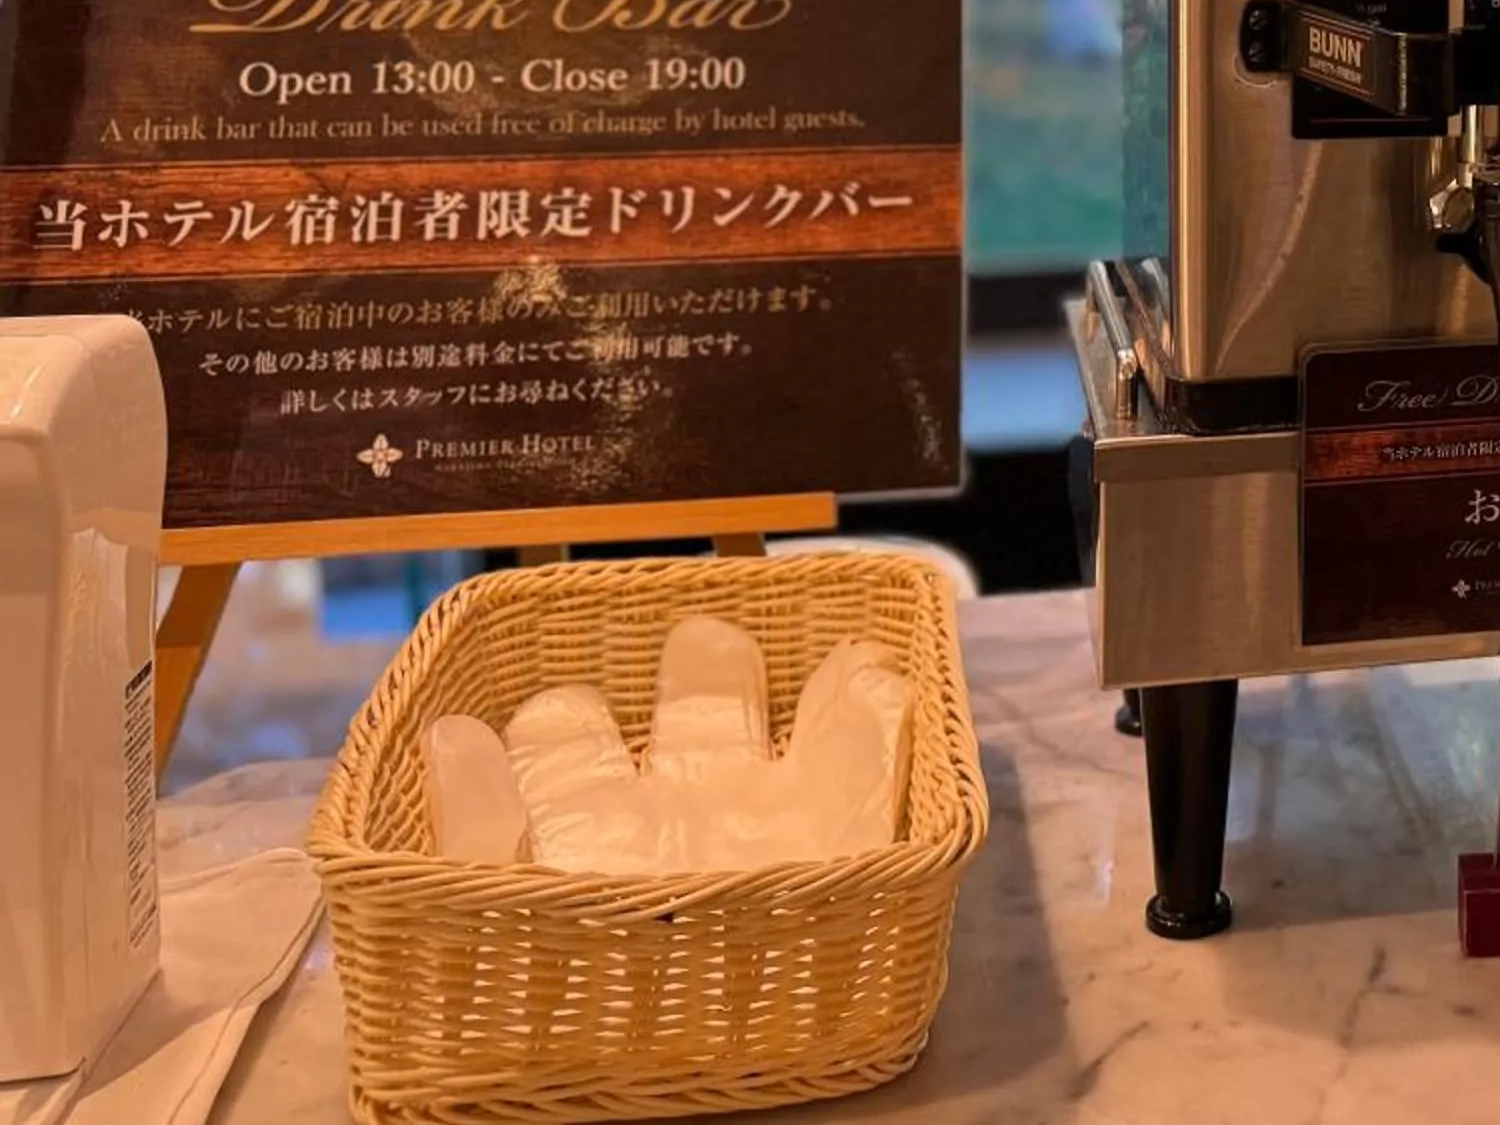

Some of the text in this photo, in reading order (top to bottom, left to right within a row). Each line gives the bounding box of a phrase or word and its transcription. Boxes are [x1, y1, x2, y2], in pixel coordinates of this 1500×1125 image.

[1309, 27, 1362, 67] BUNN
[239, 61, 352, 103] Open
[371, 61, 475, 94] 13:00
[521, 58, 628, 92] Close
[645, 56, 746, 90] 19:00
[101, 118, 123, 143] A
[133, 115, 206, 141] drink
[216, 116, 261, 140] bar
[269, 115, 318, 138] that
[326, 119, 372, 138] can
[382, 113, 412, 137] be
[423, 113, 482, 135] used
[491, 113, 541, 135] free
[582, 109, 666, 137] charge
[675, 108, 705, 137] by
[713, 106, 776, 131] hotel
[33, 182, 913, 251] 当ホテル宿泊者限定ドリンクバー
[1357, 381, 1440, 412] Free
